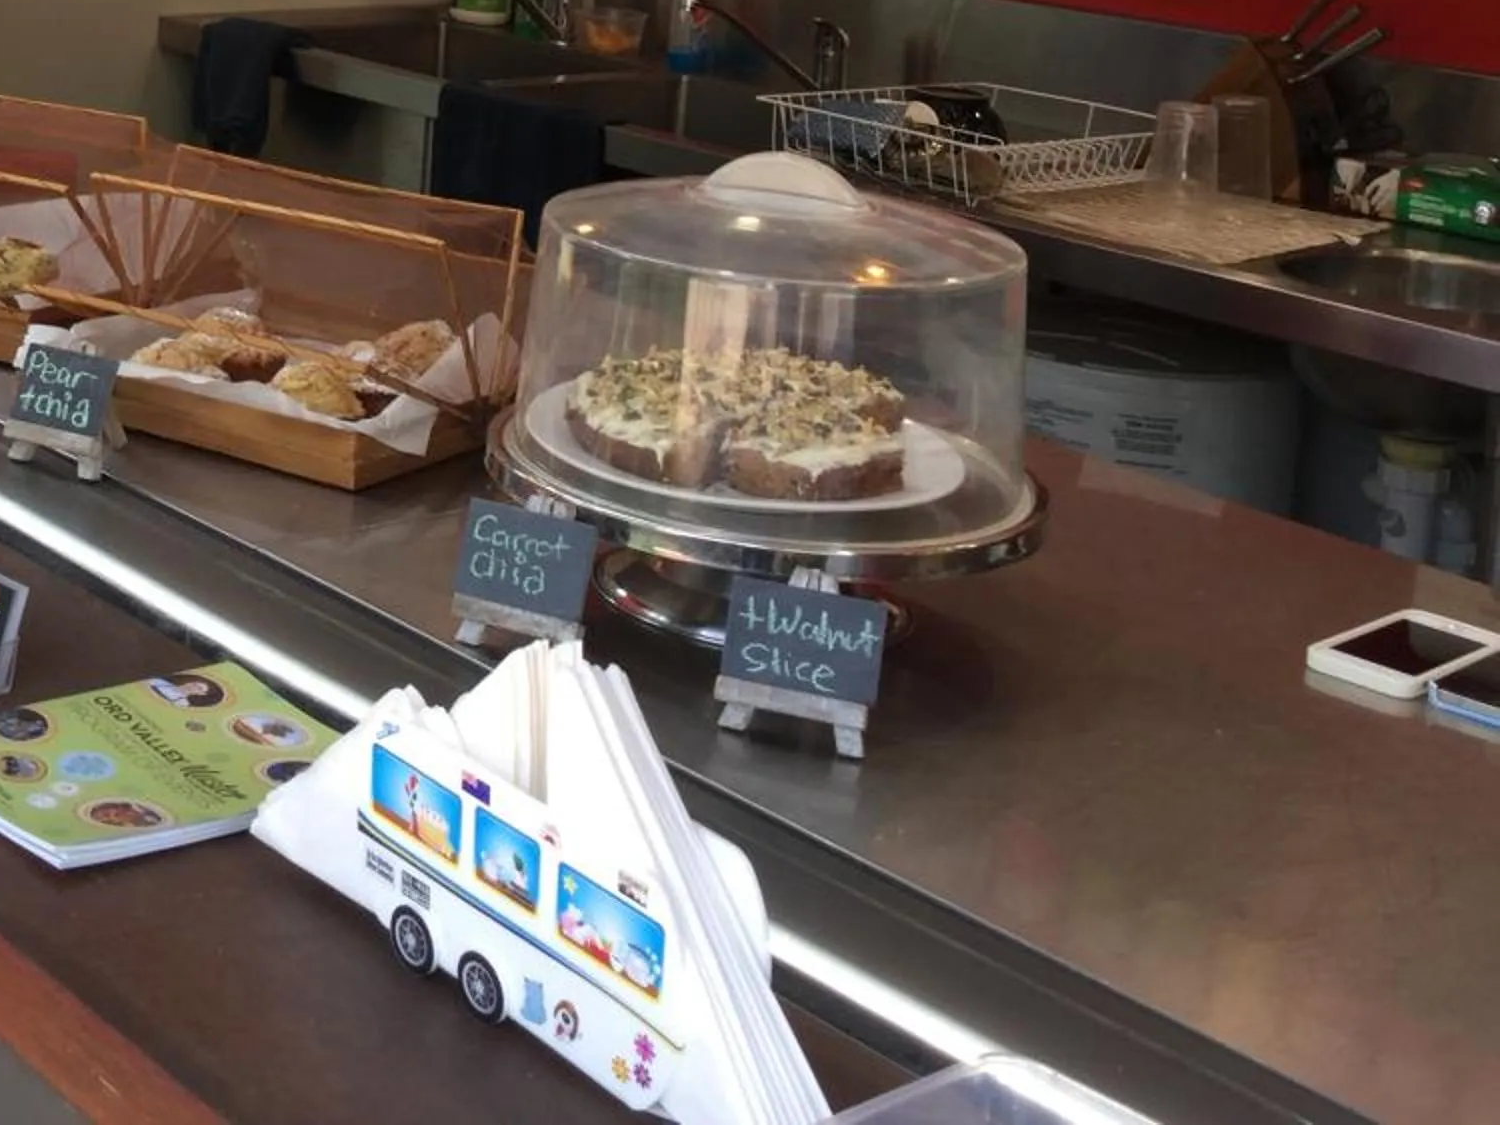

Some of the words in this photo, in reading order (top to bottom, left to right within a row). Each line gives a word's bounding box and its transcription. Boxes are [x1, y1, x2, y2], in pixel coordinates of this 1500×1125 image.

[26, 349, 99, 388] Pear
[473, 514, 572, 561] Carrot
[740, 642, 836, 693] Slice
[129, 721, 191, 766] VALLEY
